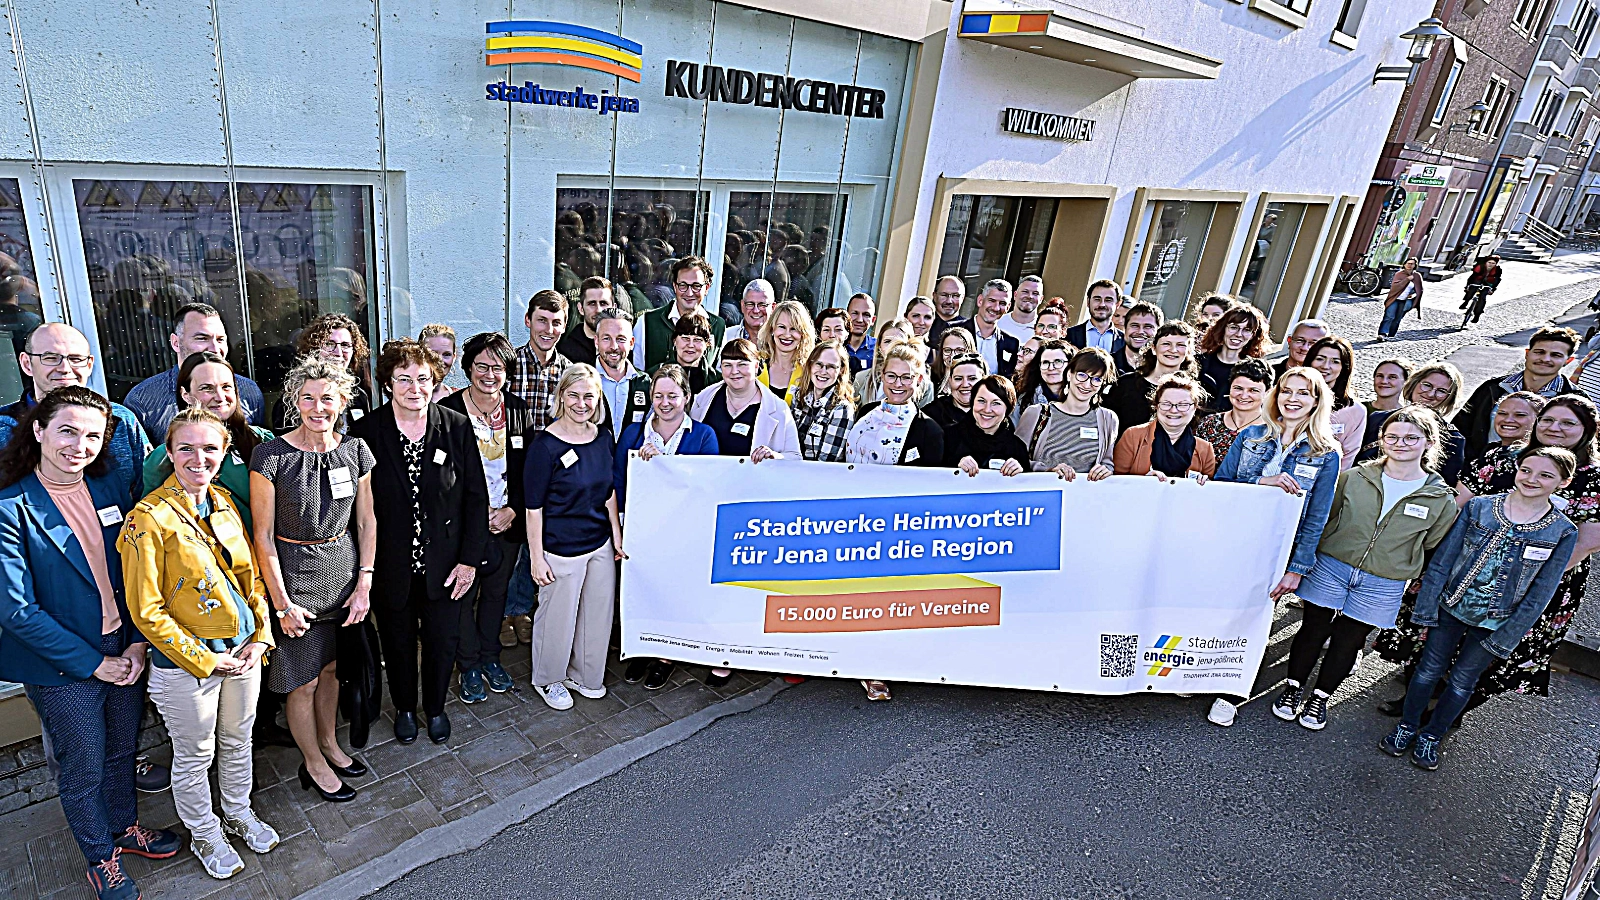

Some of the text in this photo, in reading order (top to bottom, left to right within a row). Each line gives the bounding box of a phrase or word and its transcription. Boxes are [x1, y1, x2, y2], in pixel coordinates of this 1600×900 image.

[486, 81, 640, 115] stadtwerke jena
[664, 59, 886, 119] KUNDENCENTER
[1007, 109, 1096, 141] WILLKOMMEN
[733, 513, 886, 540] „Stadtwerke
[730, 537, 1013, 565] für Jena und die Region
[777, 600, 990, 621] 15.000 Euro für Vereine
[705, 645, 725, 653] Energie
[784, 651, 804, 659] Freizeit
[808, 653, 829, 661] Services
[1188, 636, 1248, 650] stadtwerke
[1143, 651, 1195, 667] energie
[1196, 654, 1244, 667] jena-pößneck
